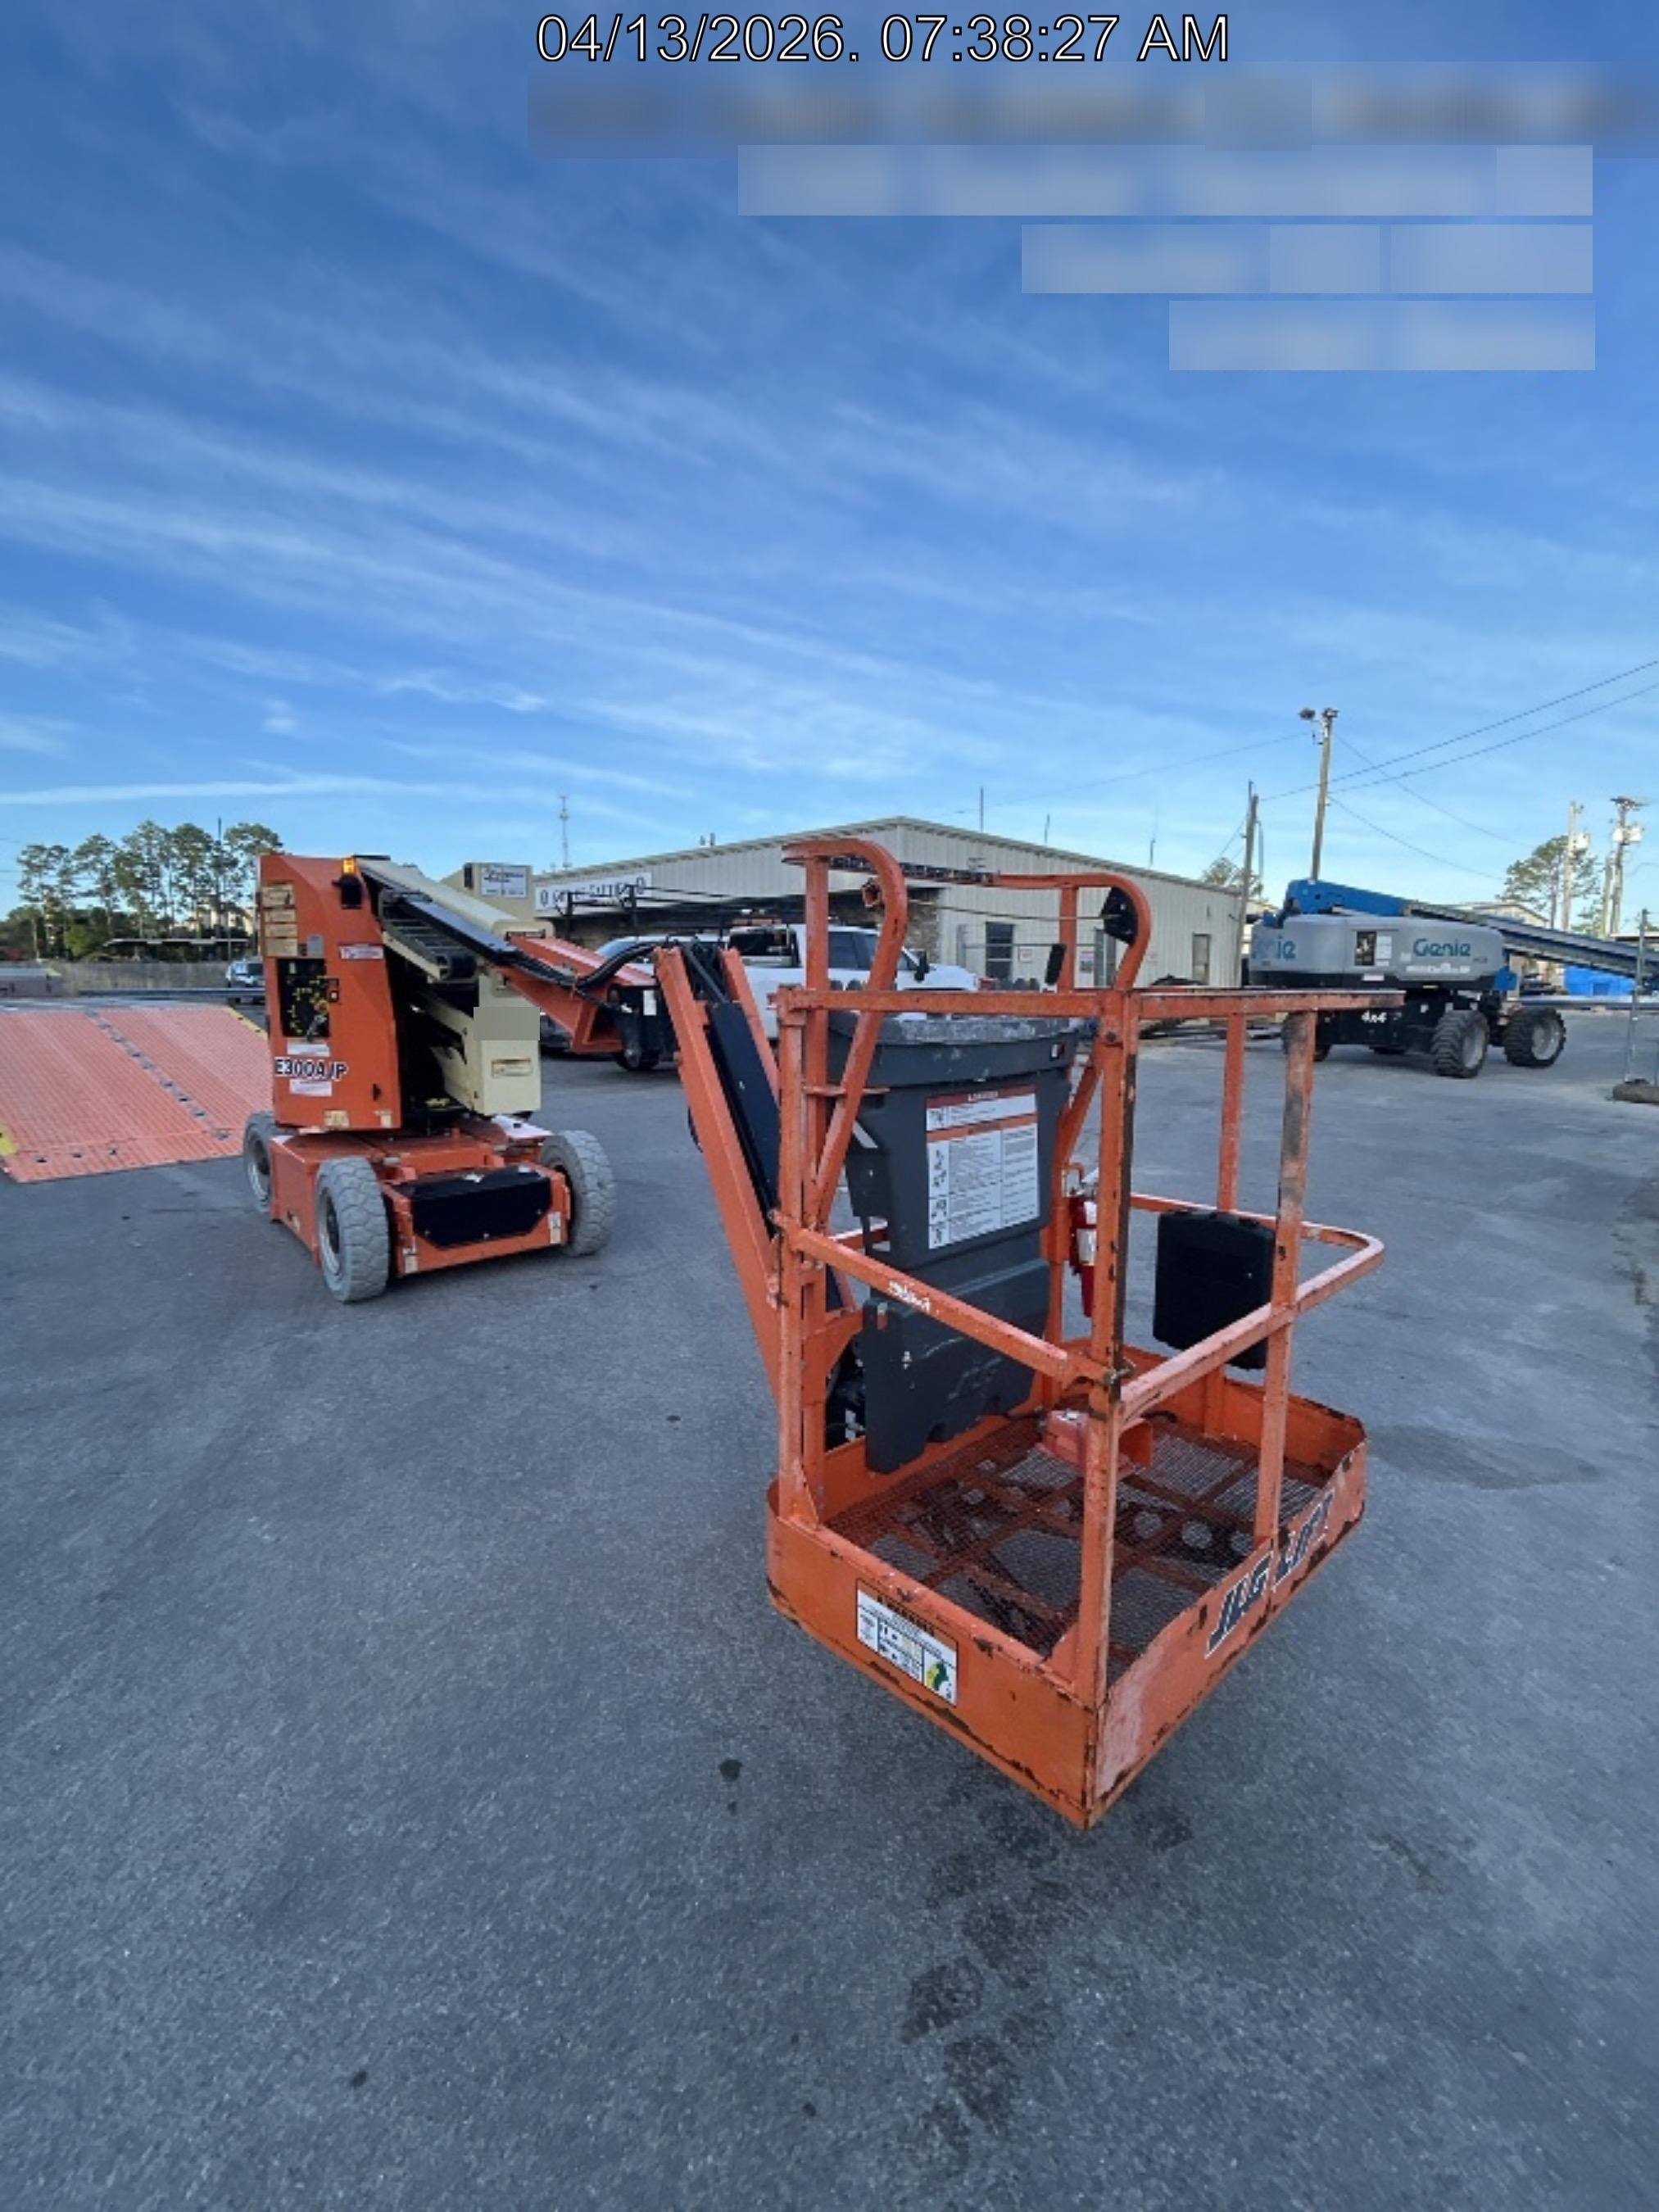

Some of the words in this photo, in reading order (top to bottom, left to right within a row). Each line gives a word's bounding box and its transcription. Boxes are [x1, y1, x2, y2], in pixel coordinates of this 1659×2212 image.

[1413, 937, 1471, 957] Genie
[274, 1057, 348, 1081] E300AJP
[1203, 1550, 1273, 1659] JLG
